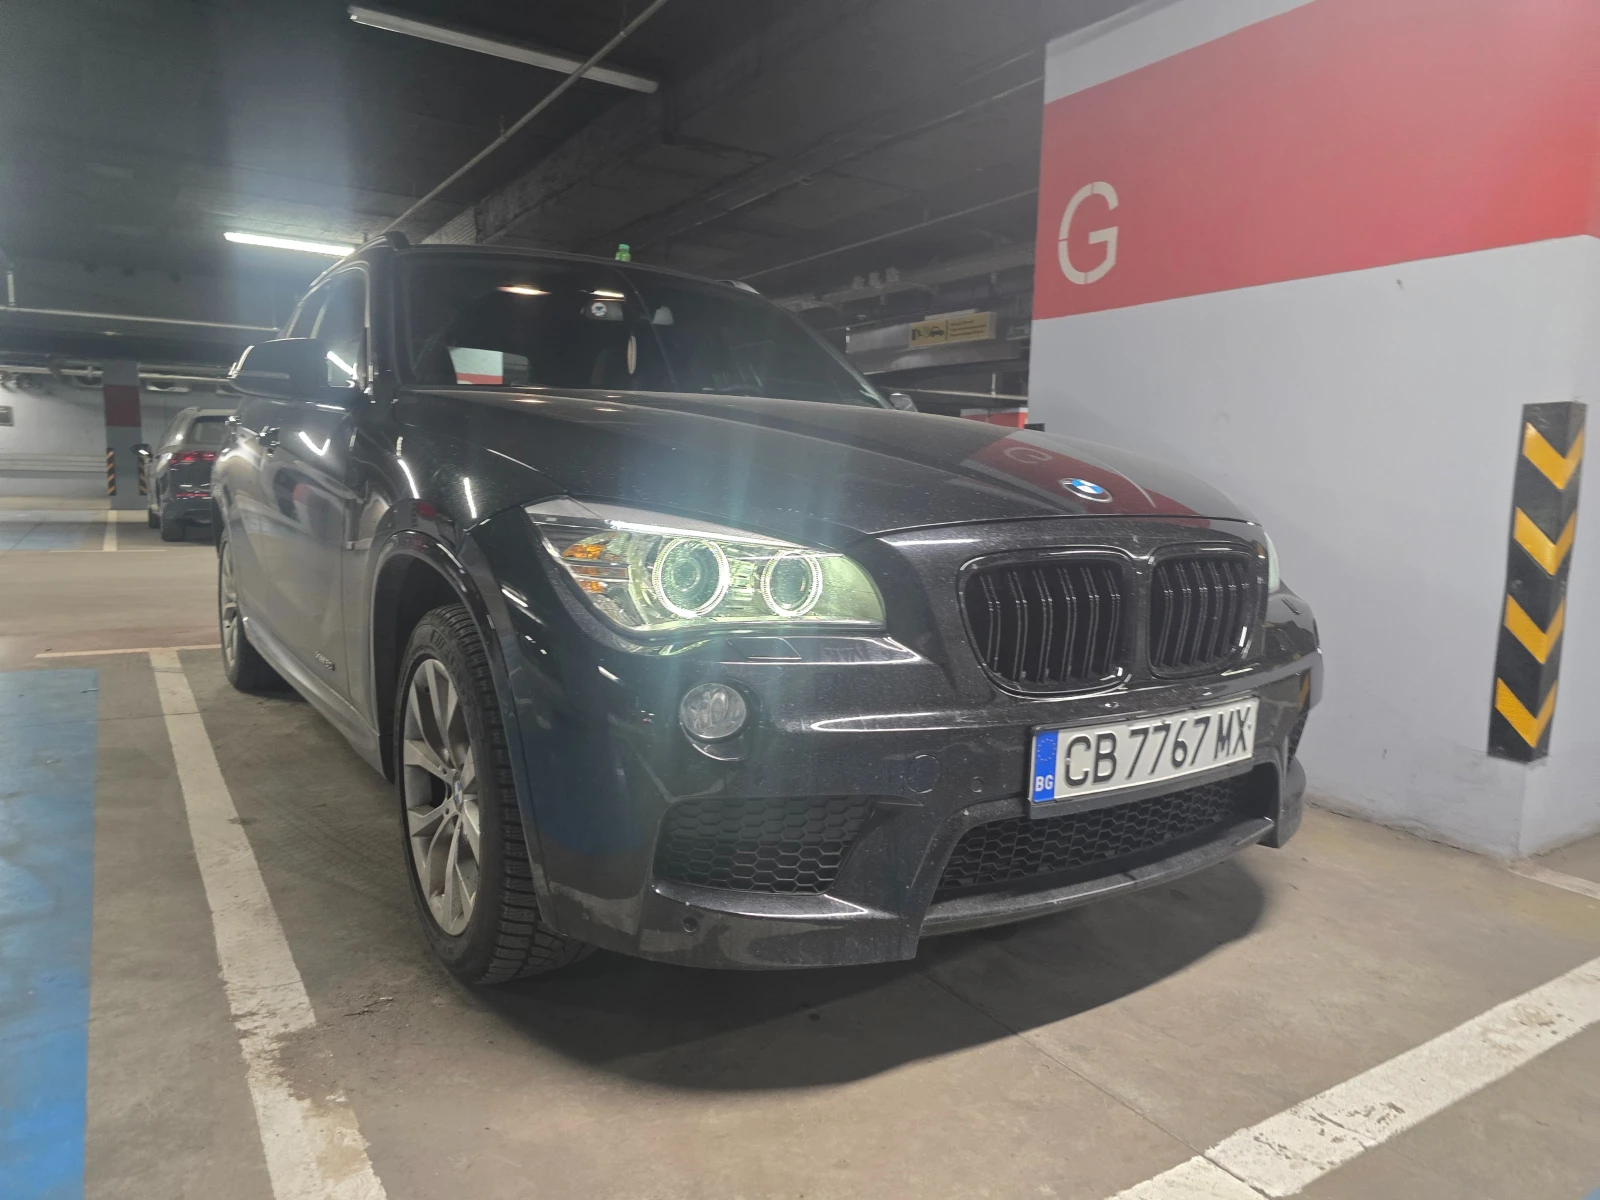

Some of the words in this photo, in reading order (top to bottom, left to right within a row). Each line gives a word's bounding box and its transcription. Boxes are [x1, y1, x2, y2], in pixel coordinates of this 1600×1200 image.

[1058, 181, 1119, 284] G
[1035, 775, 1054, 792] BG
[1064, 732, 1117, 787] CB
[1126, 715, 1211, 781] 7767
[1213, 705, 1252, 760] MX
